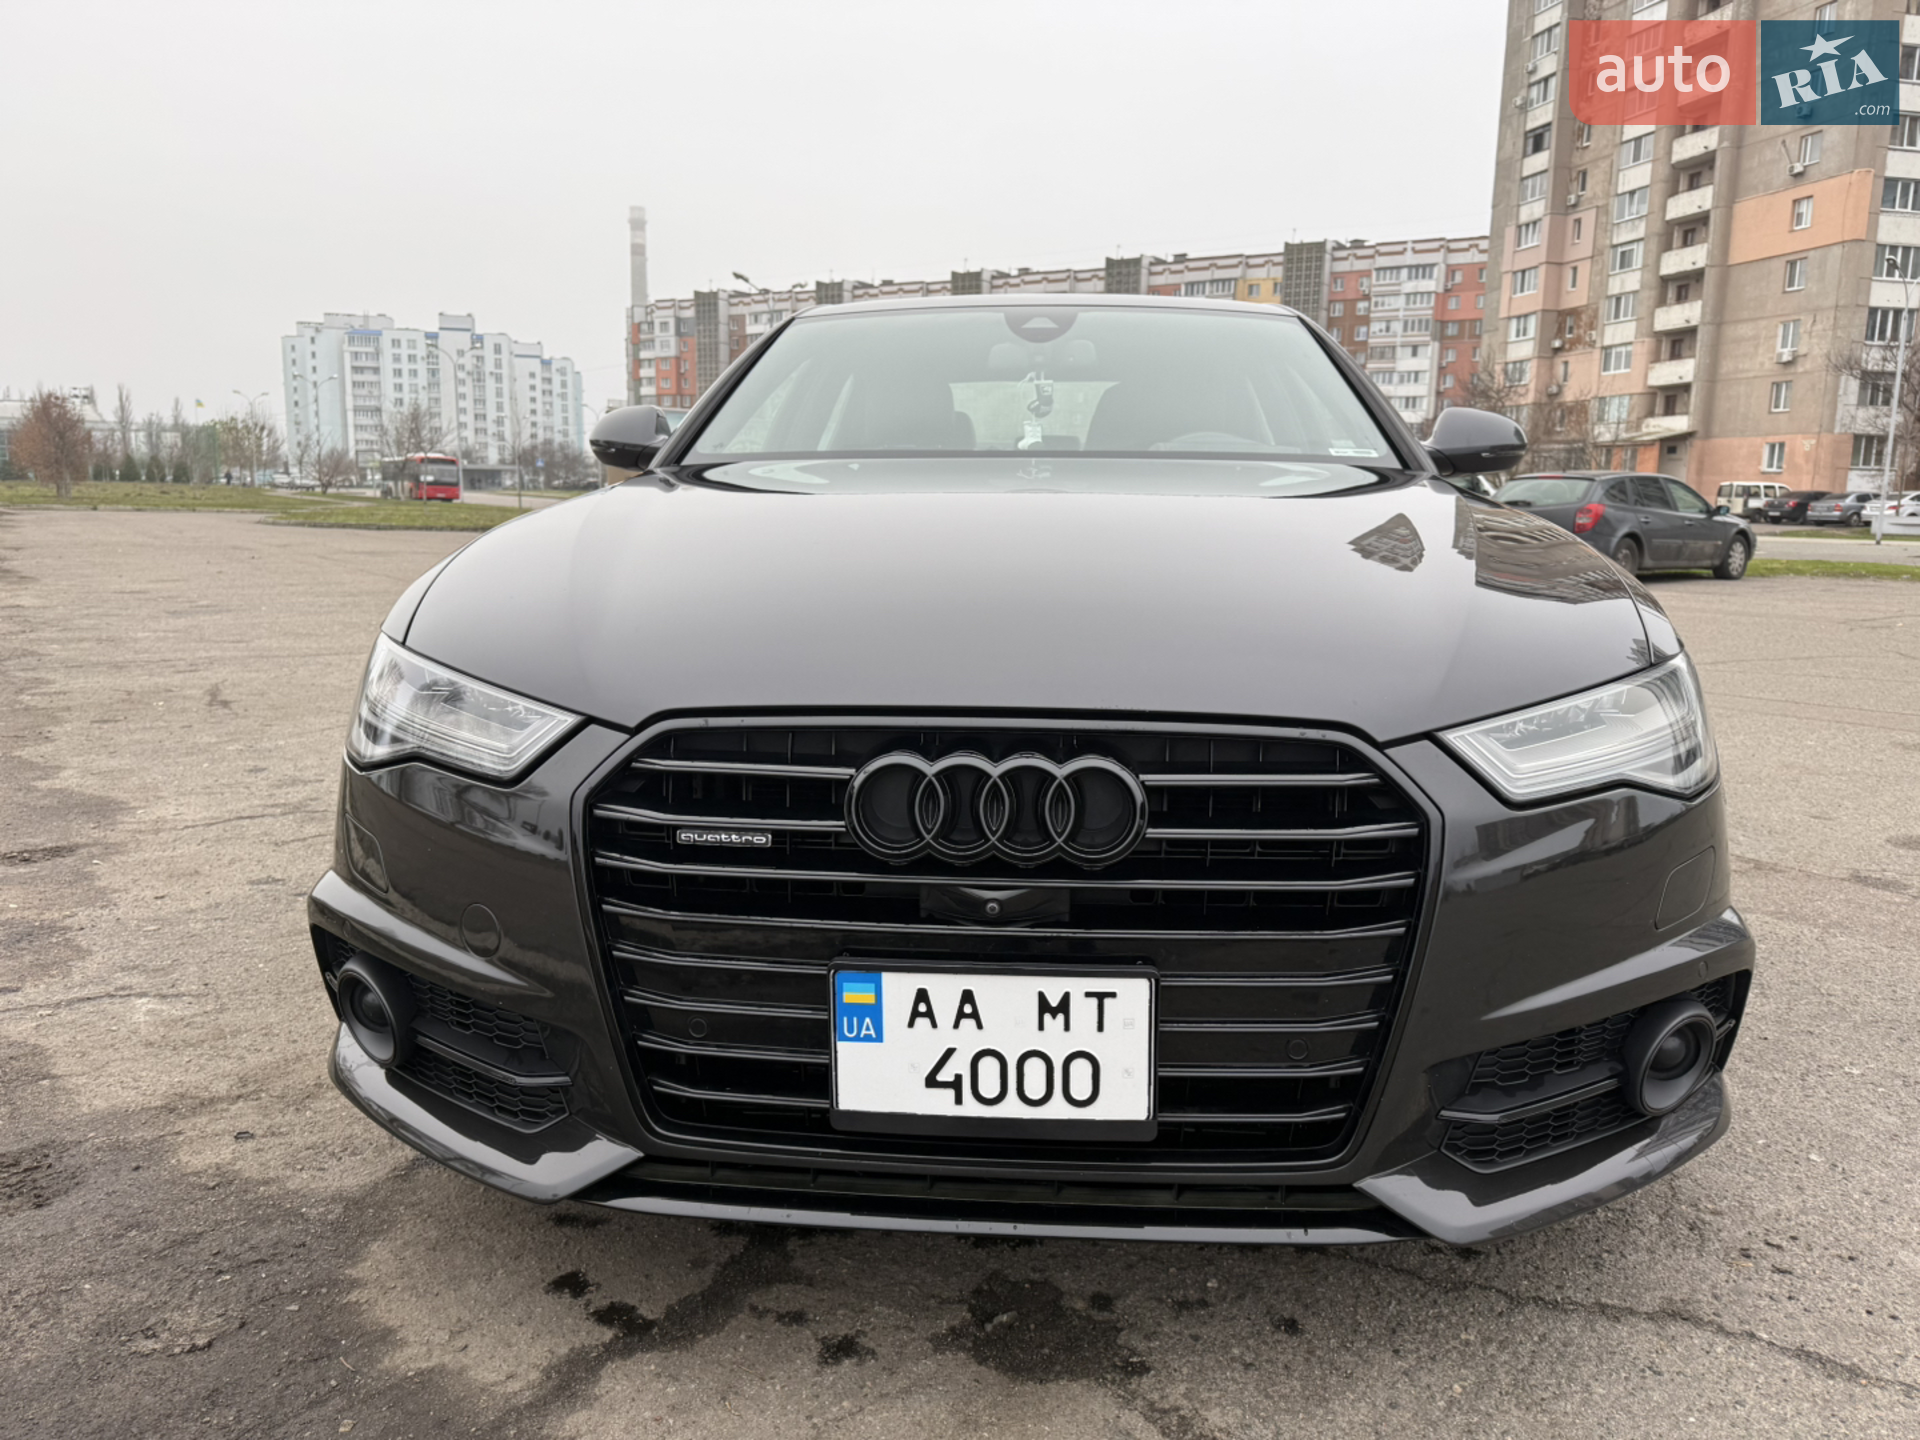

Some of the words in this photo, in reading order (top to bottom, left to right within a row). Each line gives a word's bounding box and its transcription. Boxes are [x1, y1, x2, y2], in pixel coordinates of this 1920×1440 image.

[680, 833, 767, 844] quattro
[843, 1016, 877, 1038] UA
[907, 987, 984, 1030] AA
[1037, 990, 1118, 1033] MT
[924, 1046, 1101, 1108] 4000
